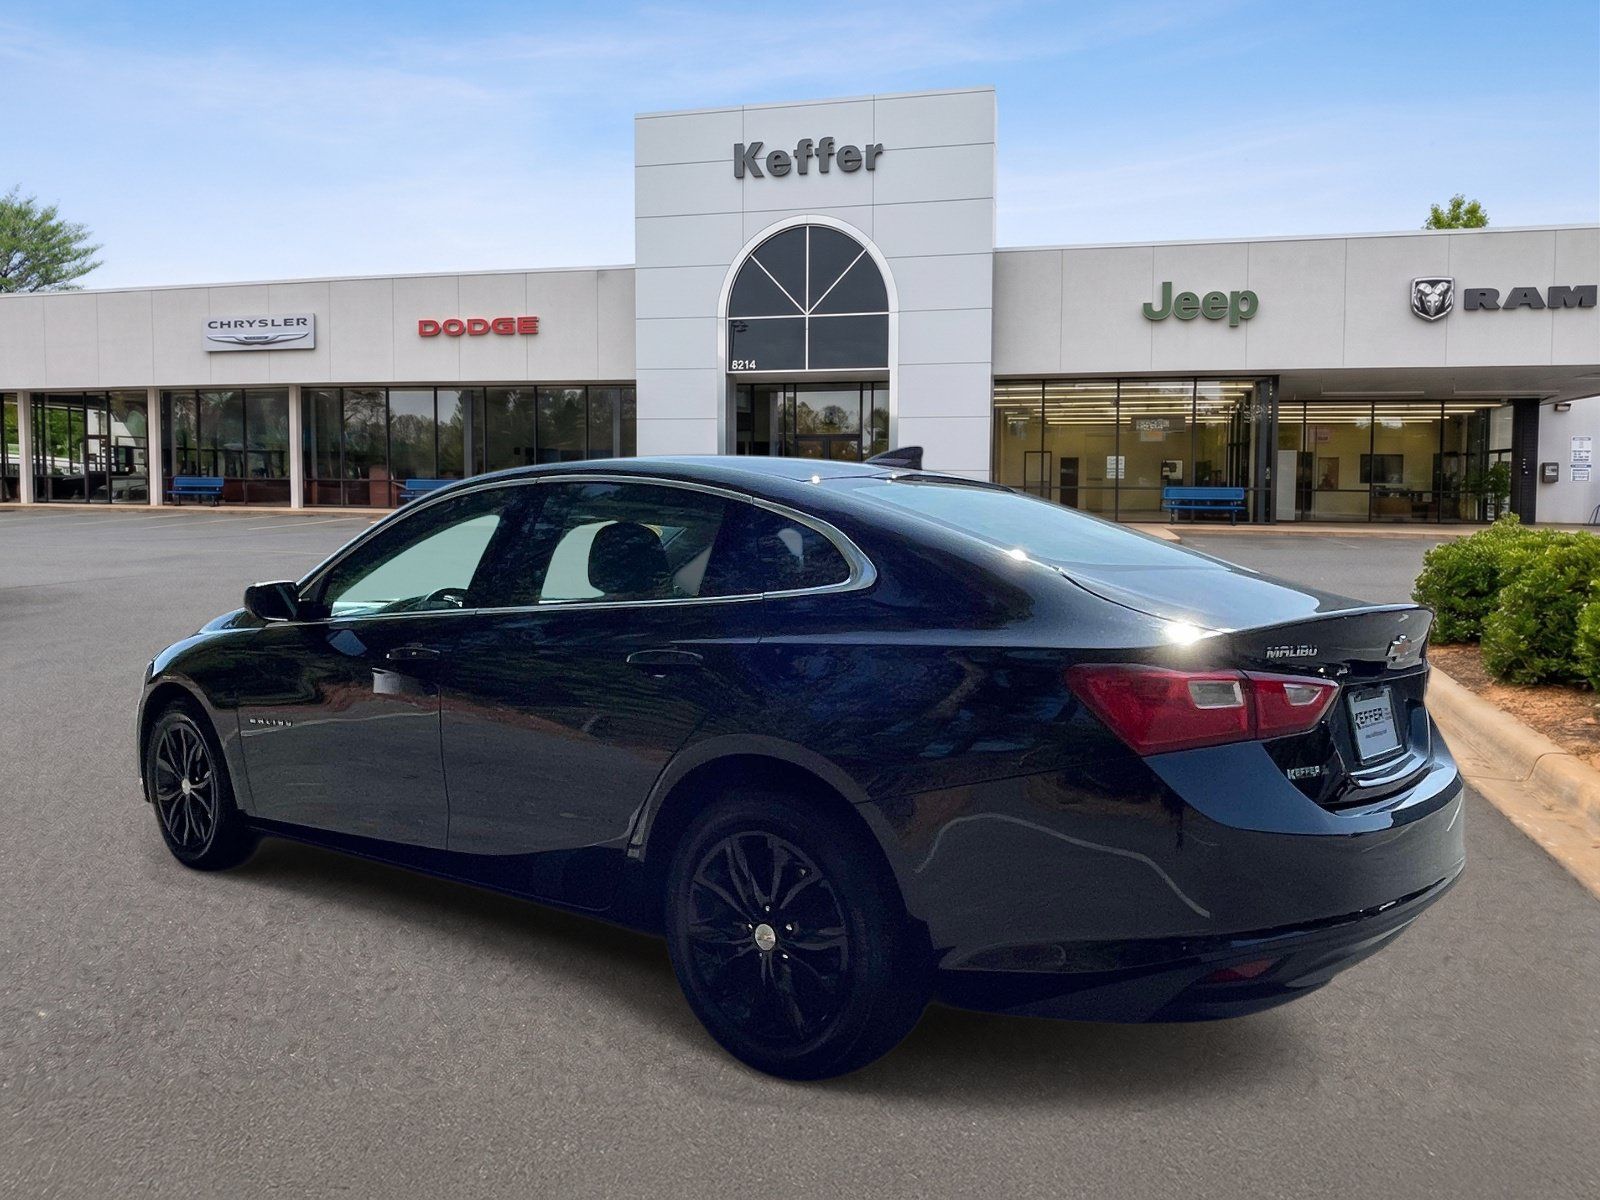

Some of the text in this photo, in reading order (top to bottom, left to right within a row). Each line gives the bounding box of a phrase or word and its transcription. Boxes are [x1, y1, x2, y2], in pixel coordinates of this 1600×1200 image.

[733, 136, 883, 178] Keffer
[1142, 281, 1259, 327] Jeep
[1464, 285, 1597, 310] RAM
[207, 318, 308, 329] CHRYSLER
[418, 316, 539, 337] DODGE
[732, 359, 757, 370] 8214
[1265, 645, 1318, 658] MALIBU
[1354, 707, 1383, 730] KEFFER
